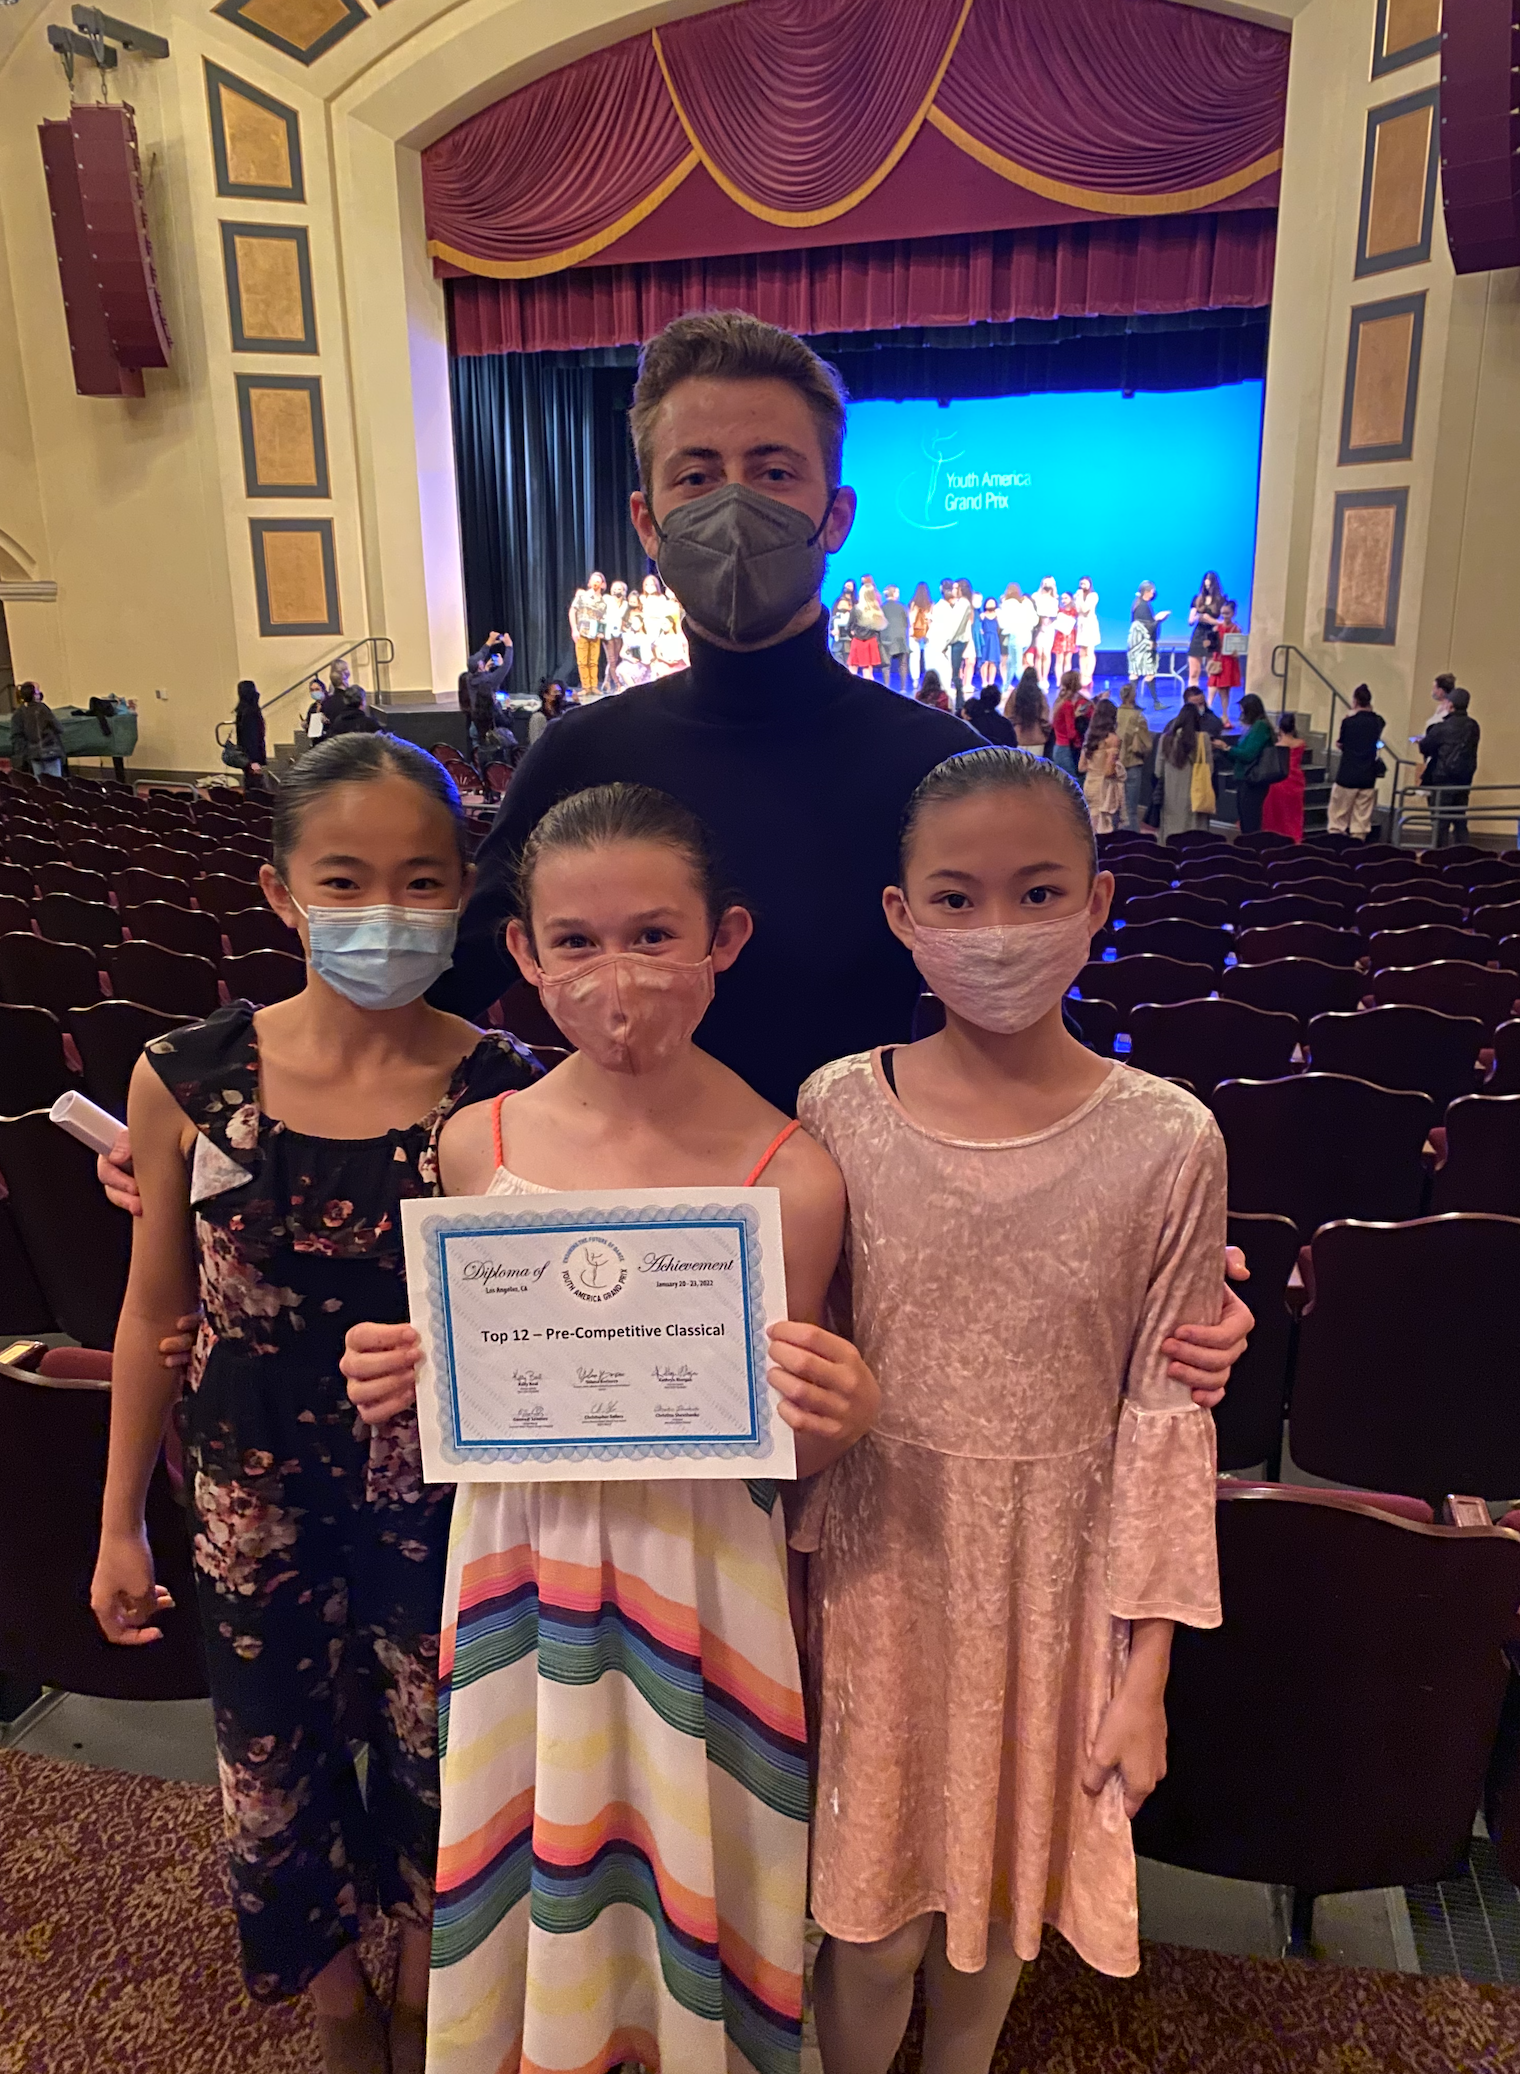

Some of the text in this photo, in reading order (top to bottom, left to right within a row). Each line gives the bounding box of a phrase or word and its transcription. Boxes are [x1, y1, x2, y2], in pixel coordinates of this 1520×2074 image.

[945, 470, 1032, 488] Youth America
[944, 490, 1010, 512] Grand Prix
[462, 1252, 735, 1286] Diploma of Achievement
[485, 1286, 496, 1294] Los
[496, 1286, 519, 1295] Angeles,
[561, 1268, 628, 1303] YOUTH AMERICA GRAND PRIX
[656, 1280, 678, 1289] January
[481, 1330, 508, 1344] Top
[513, 1329, 530, 1341] 12
[546, 1325, 662, 1341] Pre-Competitive
[666, 1323, 725, 1337] Classical
